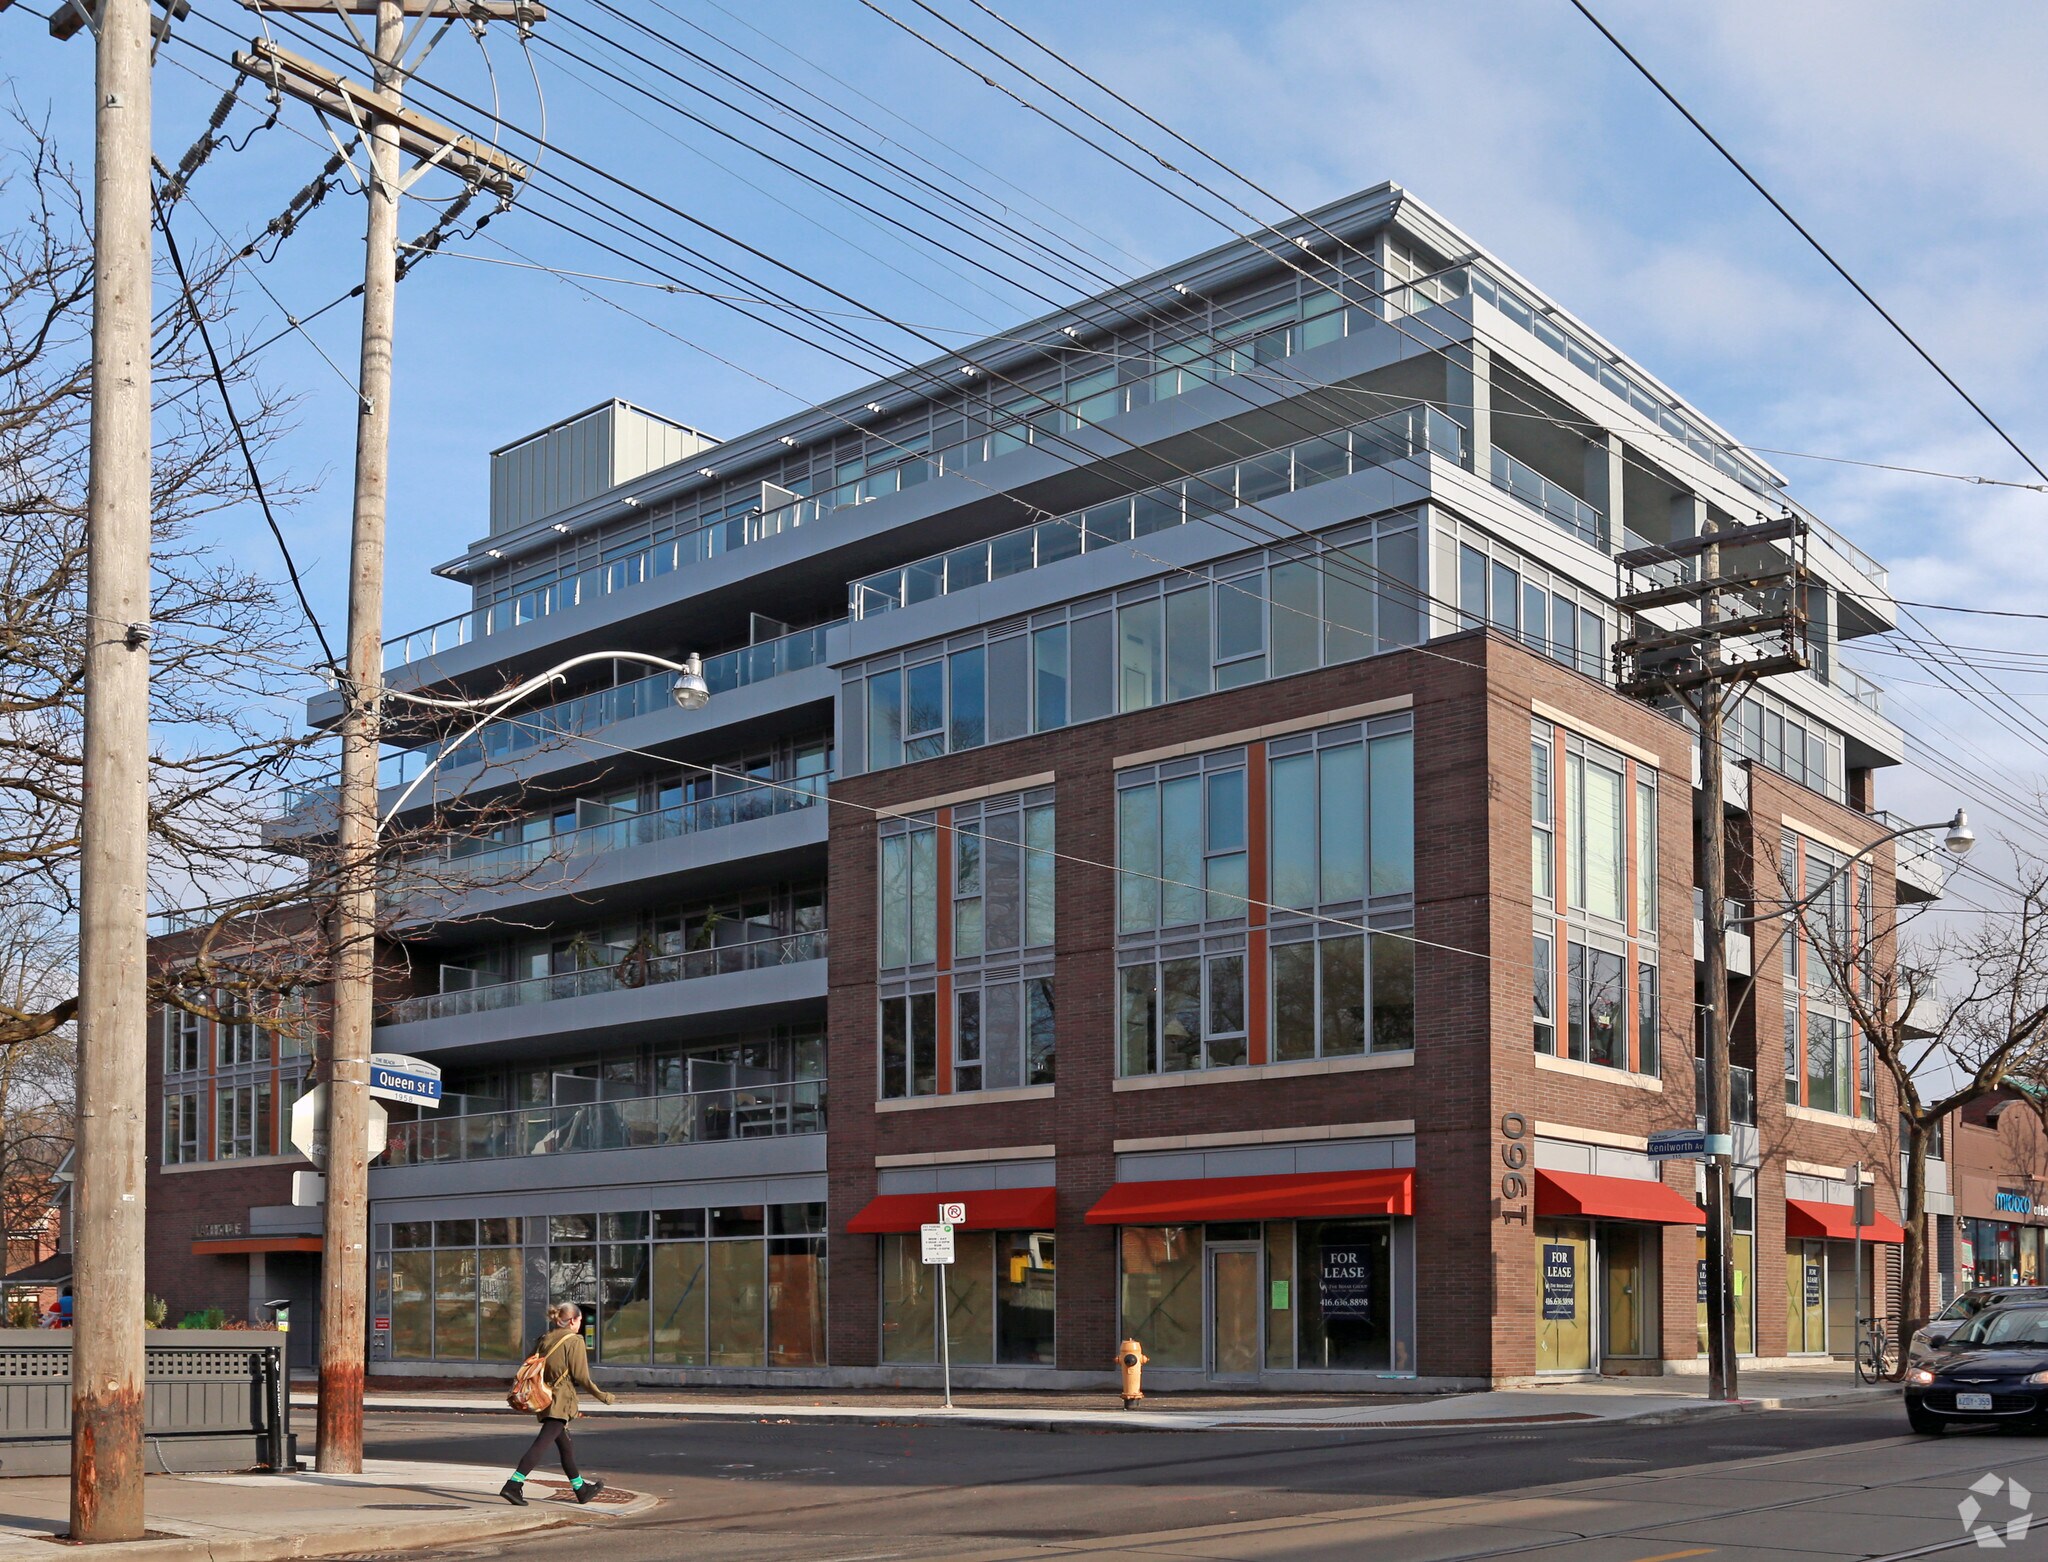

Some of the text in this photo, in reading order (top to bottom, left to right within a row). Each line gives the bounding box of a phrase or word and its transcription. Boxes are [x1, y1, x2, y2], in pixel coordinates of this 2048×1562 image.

[380, 1071, 414, 1091] Queen
[417, 1081, 426, 1093] St
[428, 1081, 434, 1095] E
[394, 1093, 413, 1103] 1958
[1648, 1142, 1693, 1152] Kenilworth
[1502, 1112, 1527, 1226] 1960
[1995, 1192, 2032, 1214] midoco
[1330, 1253, 1358, 1264] FOR
[1552, 1252, 1568, 1263] FOR
[1324, 1267, 1365, 1278] LEASE
[1547, 1266, 1571, 1278] LEASE
[1320, 1298, 1368, 1306] 416.636.8898
